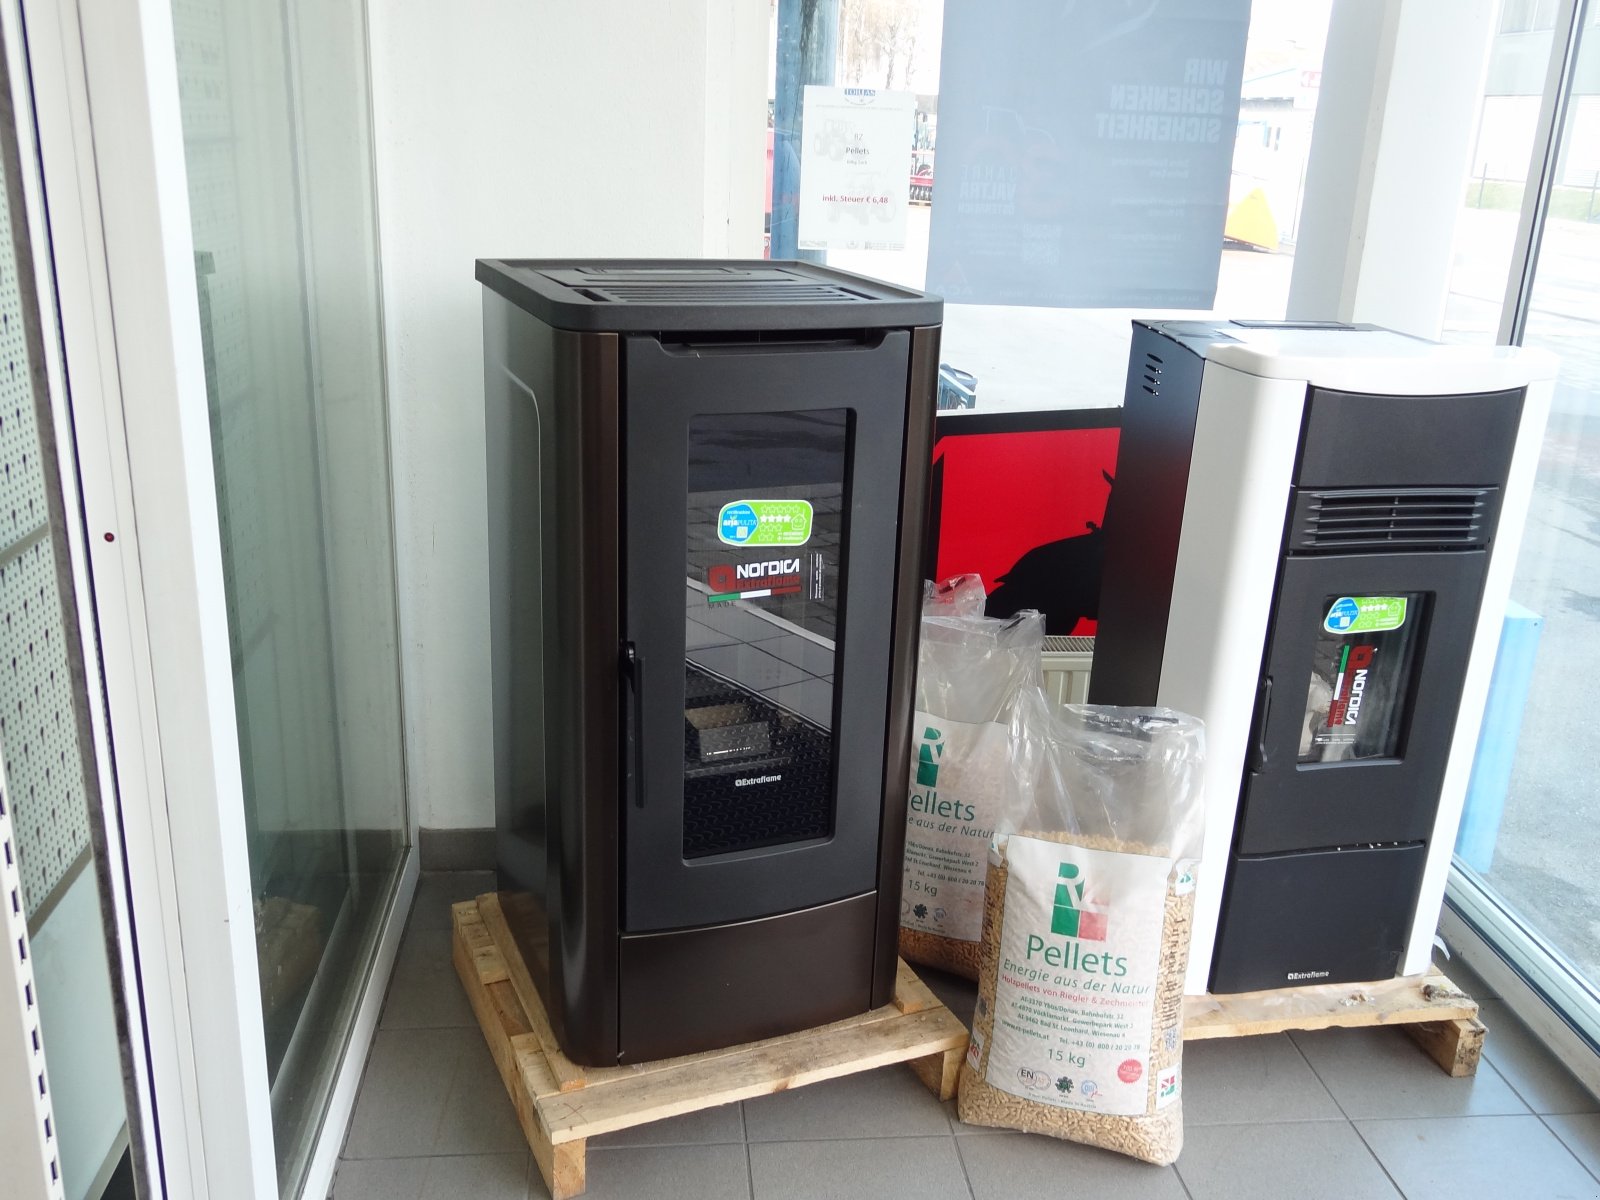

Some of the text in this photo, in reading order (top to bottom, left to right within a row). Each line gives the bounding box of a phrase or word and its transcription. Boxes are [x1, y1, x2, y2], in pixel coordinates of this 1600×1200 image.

[845, 146, 870, 155] Pellets
[840, 195, 865, 203] Steuer
[736, 558, 800, 579] NORDICA
[1344, 669, 1369, 725] NORDICA
[909, 789, 976, 822] ellets
[916, 819, 935, 830] aus
[938, 820, 958, 834] der
[960, 825, 995, 840] Natur
[909, 879, 938, 897] 15 kg
[1026, 933, 1128, 977] Pellets
[1002, 957, 1150, 996] Energie aus der Natur
[1001, 974, 1040, 993] Holzpellets
[1042, 988, 1058, 996] von
[1060, 990, 1089, 1003] Riegler
[1091, 996, 1098, 1004] &
[1049, 1048, 1086, 1068] 15 kg
[1021, 1069, 1034, 1079] EN
